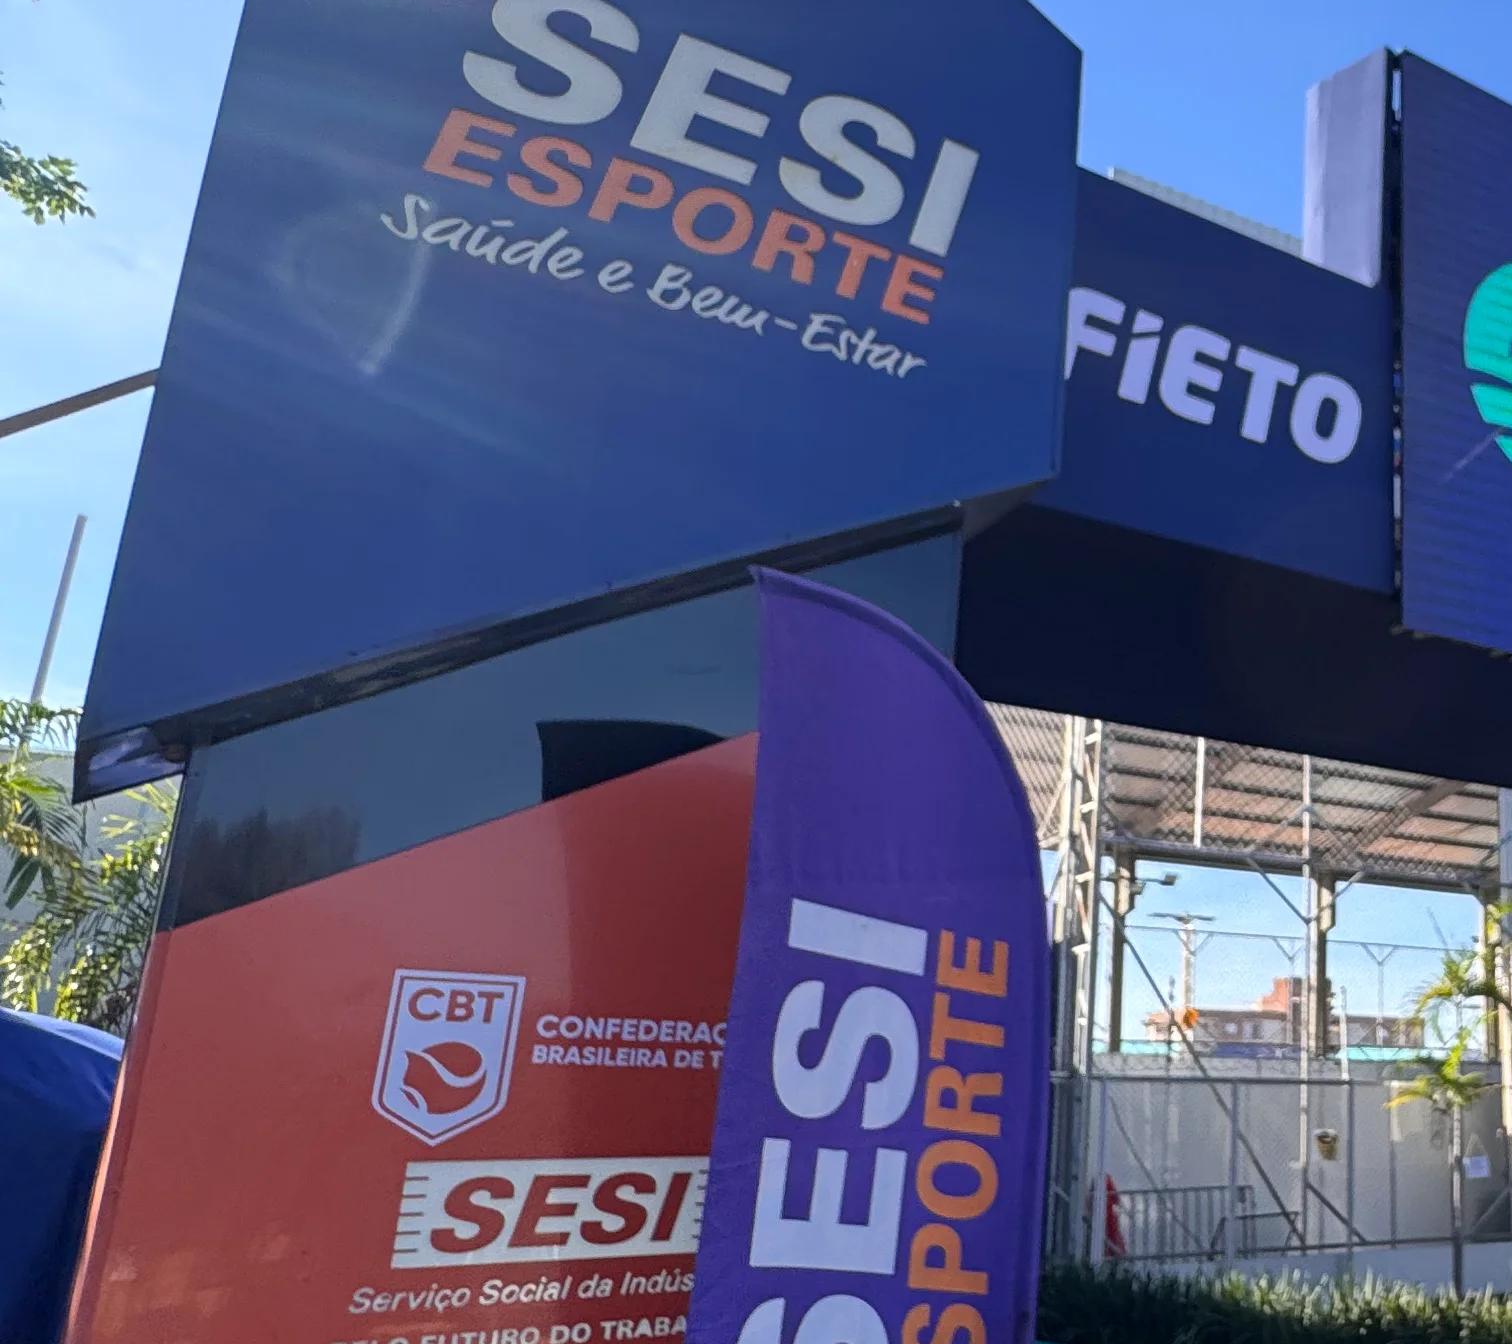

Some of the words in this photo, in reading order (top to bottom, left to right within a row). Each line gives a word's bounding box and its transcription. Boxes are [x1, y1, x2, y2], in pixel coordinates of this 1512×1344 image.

[423, 108, 945, 325] ESPORTE
[380, 193, 584, 281] Saúde
[597, 259, 635, 294] e
[646, 262, 927, 379] Bem-Estar
[408, 987, 505, 1024] CBT
[532, 1043, 668, 1068] BRASILEIRA
[673, 1049, 704, 1069] DE
[430, 1171, 692, 1254] SESI
[348, 1283, 470, 1316] Serviço
[479, 1270, 571, 1306] Social
[577, 1272, 613, 1299] da
